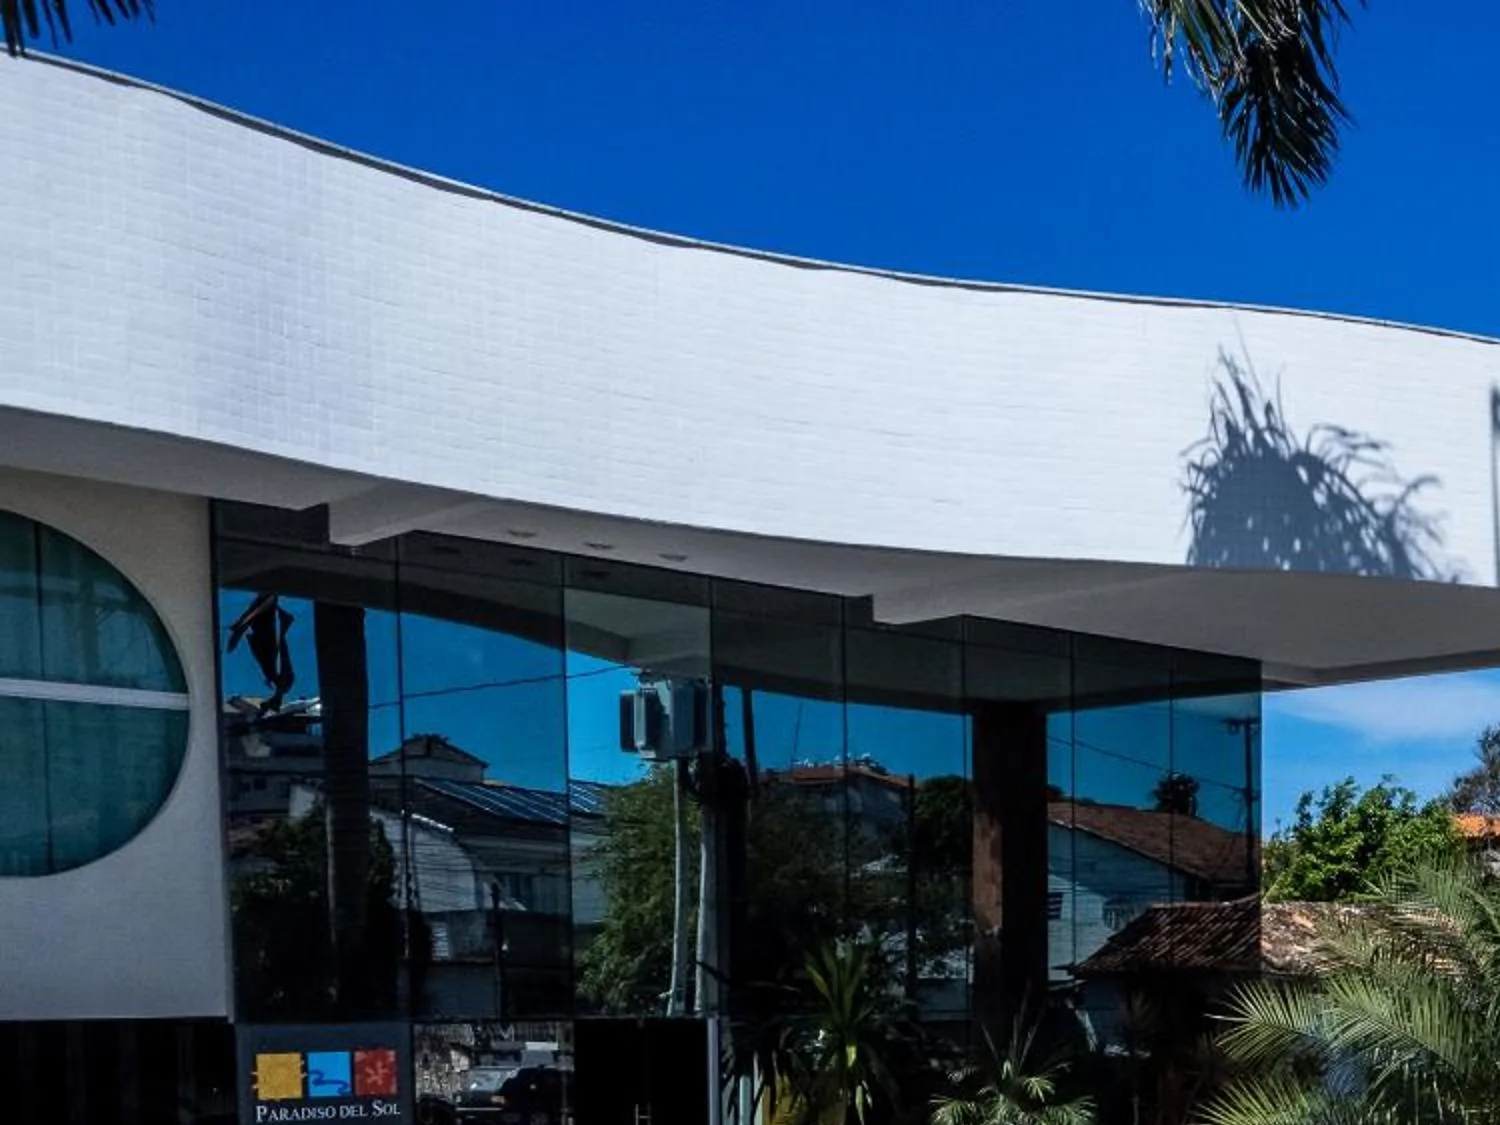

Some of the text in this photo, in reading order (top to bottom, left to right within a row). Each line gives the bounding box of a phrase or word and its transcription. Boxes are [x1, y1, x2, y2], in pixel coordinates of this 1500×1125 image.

[255, 1099, 401, 1123] PARADISO DEL SOL
